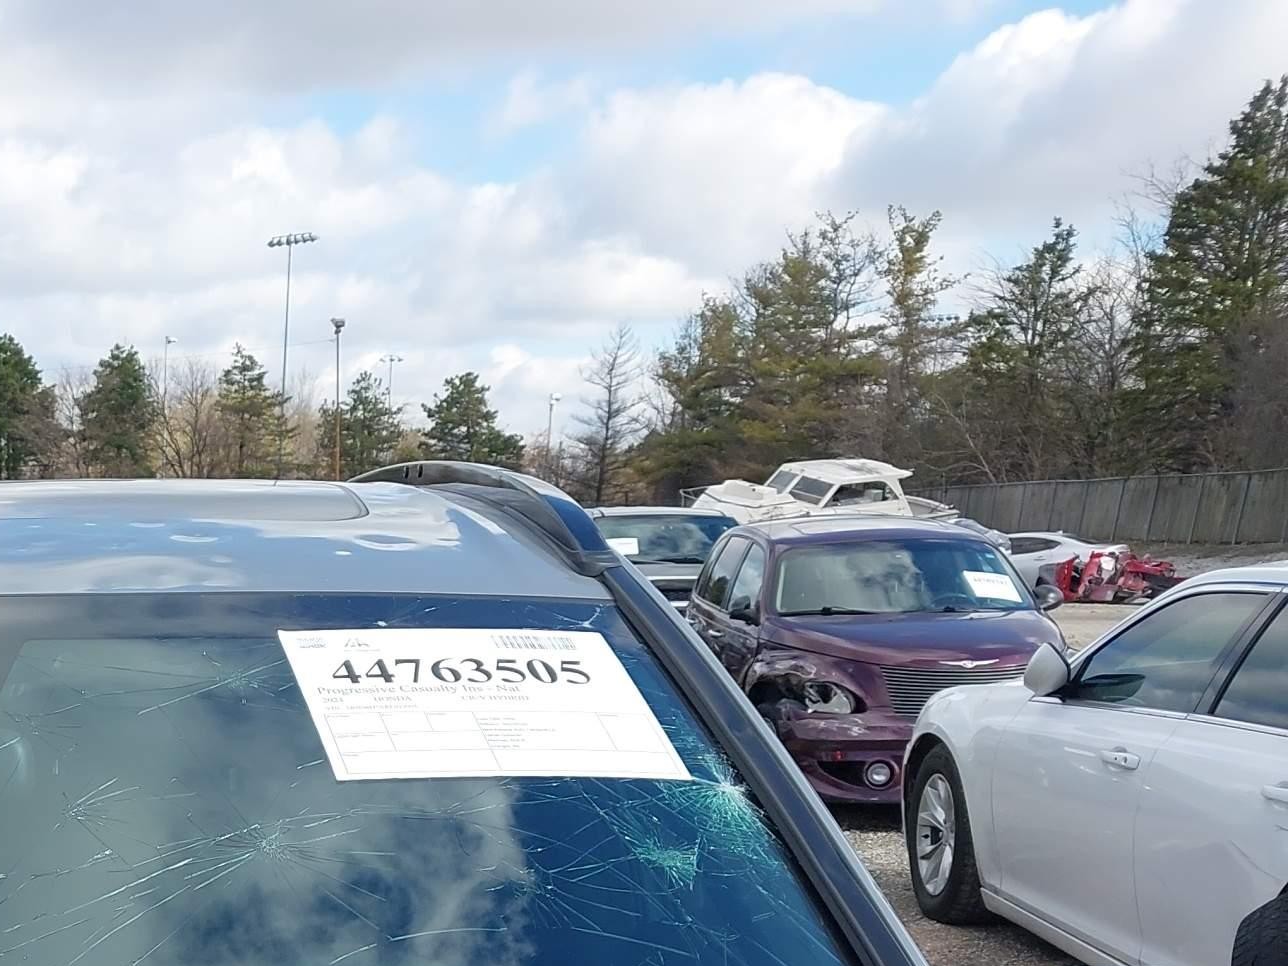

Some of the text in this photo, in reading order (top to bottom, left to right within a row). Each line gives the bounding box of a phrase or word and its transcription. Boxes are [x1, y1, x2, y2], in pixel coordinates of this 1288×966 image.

[332, 658, 591, 684] 44763505
[317, 686, 396, 696] Progressive
[399, 685, 457, 695] Casualty
